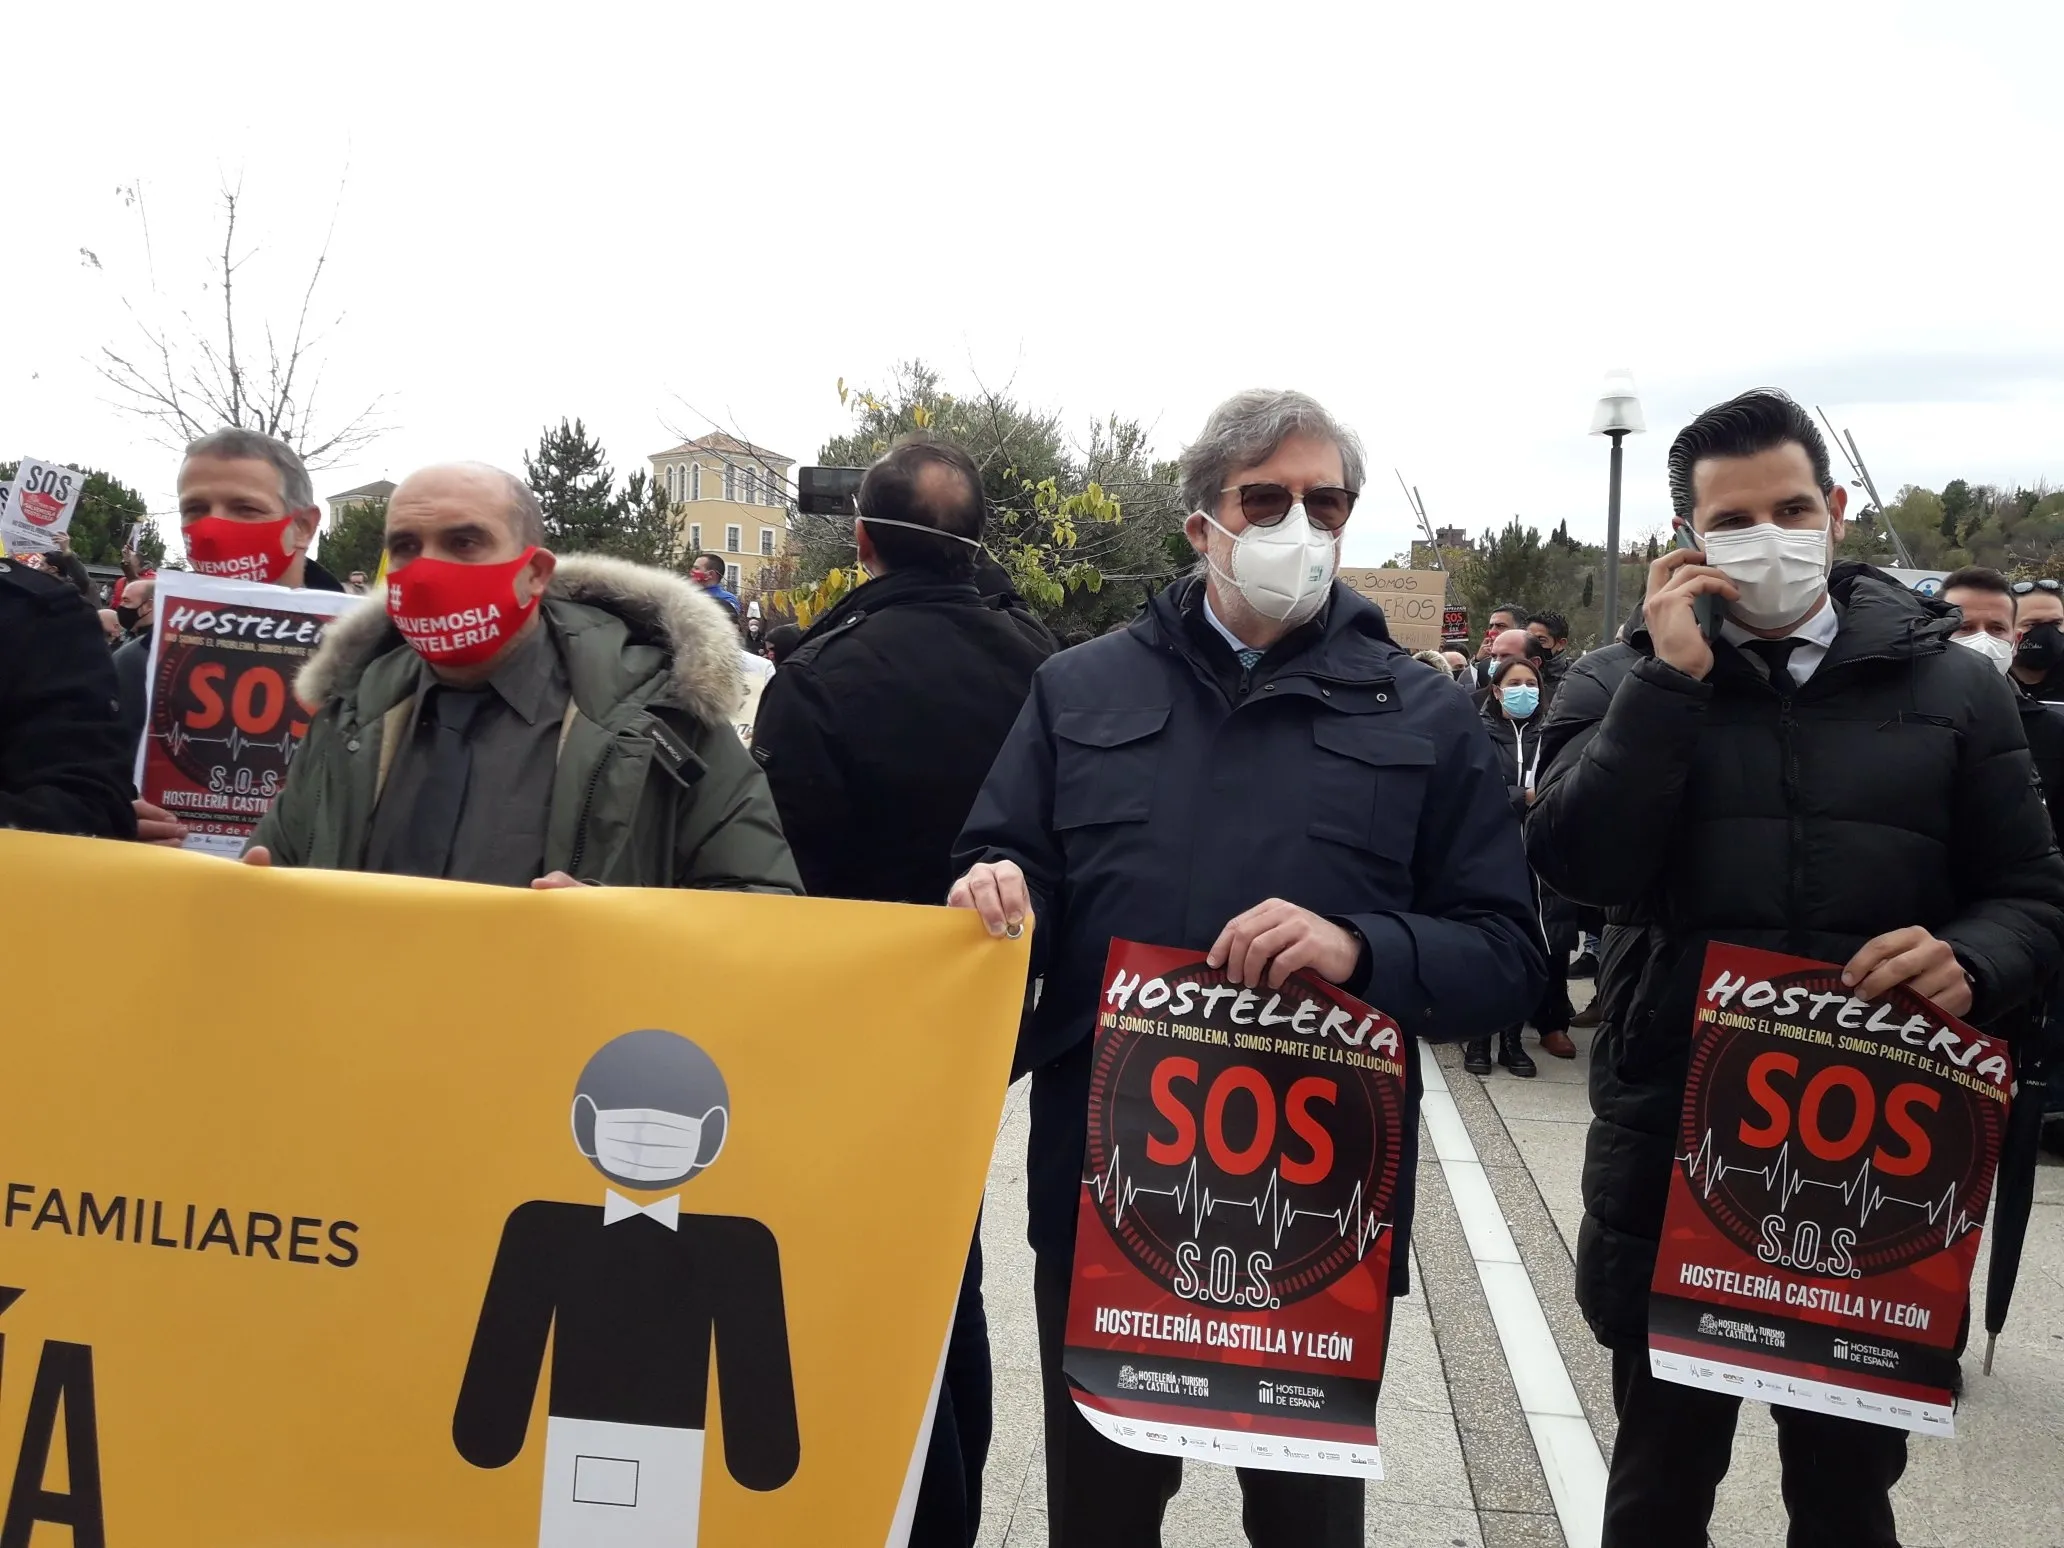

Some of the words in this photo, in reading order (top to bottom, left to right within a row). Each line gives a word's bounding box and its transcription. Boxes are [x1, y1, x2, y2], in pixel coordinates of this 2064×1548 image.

[26, 465, 72, 501] SOS
[1445, 612, 1463, 623] SOS
[162, 790, 228, 809] HOSTELERÍA
[1104, 968, 1399, 1057] HOSTELERÍA
[1704, 970, 2007, 1084] HOSTELERÍA
[1119, 1016, 1155, 1035] SOMOS
[1157, 1022, 1170, 1038] EL
[1172, 1024, 1231, 1048] PROBLEMA,
[1234, 1033, 1272, 1053] SOMOS
[1275, 1039, 1309, 1058] PARTE
[1312, 1045, 1327, 1062] DE
[1329, 1048, 1344, 1064] LA
[1346, 1051, 1403, 1078] SOLUCIÓN!
[1718, 1012, 1756, 1031] SOMOS
[1758, 1020, 1771, 1035] EL
[1773, 1022, 1835, 1049] PROBLEMA,
[1838, 1035, 1877, 1057] SOMOS
[1881, 1045, 1916, 1066] PARTE
[1918, 1055, 1934, 1073] DE
[1935, 1060, 1949, 1079] LA
[1951, 1066, 2007, 1105] SOLUCIÓN!
[1146, 1056, 1338, 1185] SOS
[1738, 1051, 1942, 1177] SOS
[5, 1182, 359, 1268] FAMILIARES
[1757, 1214, 1862, 1280] S.O.S.
[1174, 1241, 1280, 1310] S.O.S.
[1680, 1263, 1781, 1302] HOSTELERÍA
[1785, 1283, 1863, 1318] CASTILLA
[1870, 1299, 1883, 1320] Y
[1884, 1301, 1931, 1331] LEÓN
[1095, 1307, 1201, 1344] HOSTELERÍA
[1206, 1320, 1287, 1355] CASTILLA
[1292, 1330, 1304, 1356] Y
[1307, 1331, 1353, 1362] LEÓN
[1725, 1329, 1757, 1343] CASTILLA
[1759, 1326, 1785, 1340] TURISMO
[1850, 1343, 1899, 1360] HOSTELERÍA
[1182, 1375, 1209, 1388] TURISMO
[1850, 1354, 1861, 1363] DE
[1863, 1355, 1895, 1369] ESPAÑA
[1146, 1382, 1179, 1395] CASTILLA
[1276, 1383, 1324, 1398] HOSTELERÍA
[1276, 1396, 1286, 1406] DE
[1289, 1396, 1320, 1410] ESPAÑA
